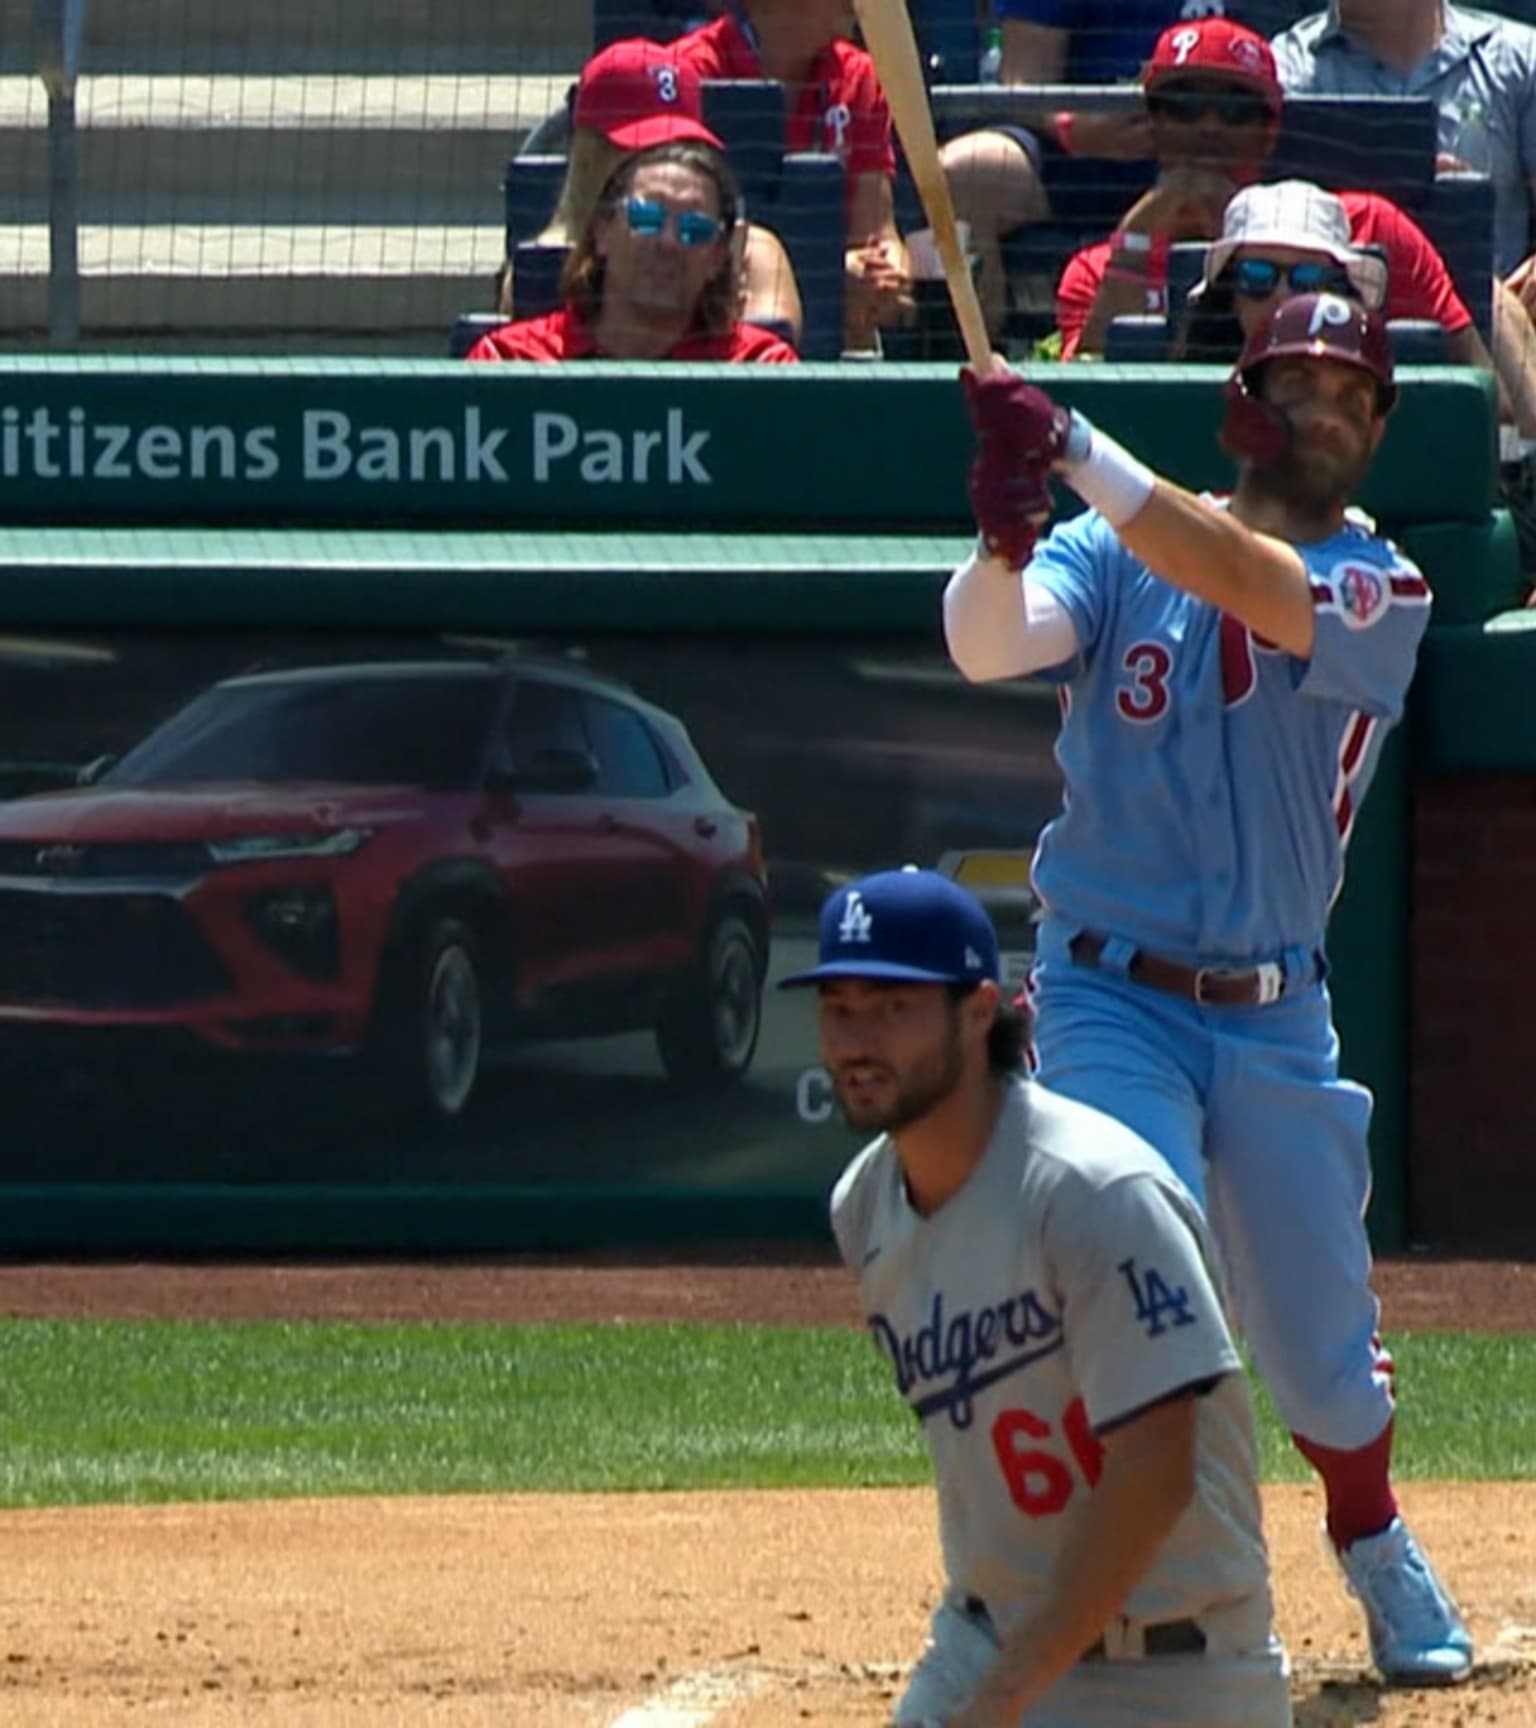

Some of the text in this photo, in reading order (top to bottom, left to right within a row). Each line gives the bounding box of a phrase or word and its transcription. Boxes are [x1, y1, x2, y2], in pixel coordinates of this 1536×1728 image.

[1171, 28, 1200, 66] P
[825, 103, 851, 148] P
[1308, 292, 1352, 336] P
[2, 405, 712, 485] itizens Bank Park
[1116, 640, 1174, 724] 3
[839, 891, 873, 943] LA
[1118, 1258, 1197, 1339] LA
